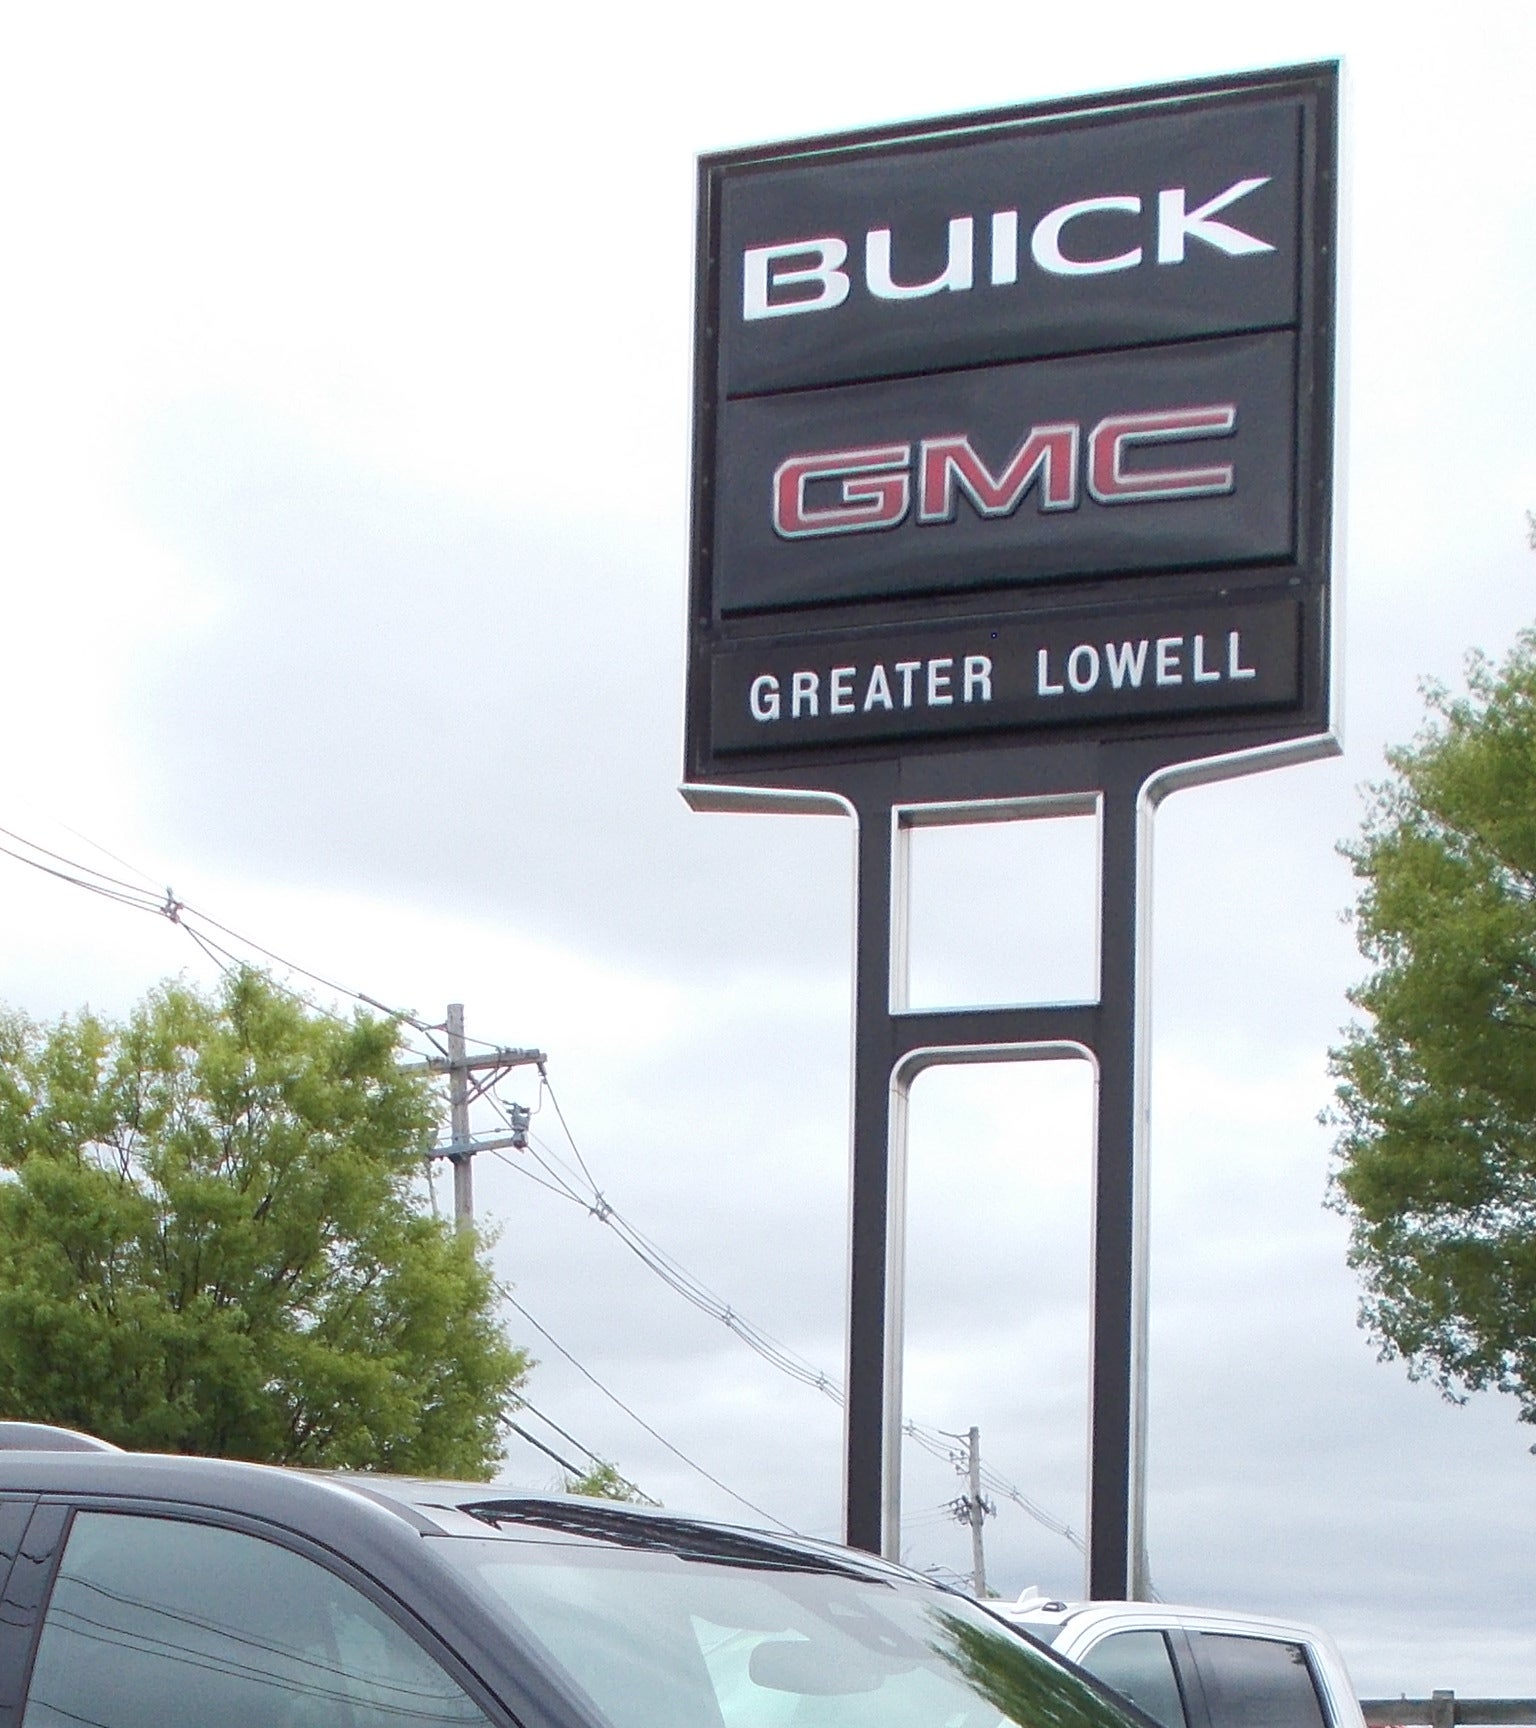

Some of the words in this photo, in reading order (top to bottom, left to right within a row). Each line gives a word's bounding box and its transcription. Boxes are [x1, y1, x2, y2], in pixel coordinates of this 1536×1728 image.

[743, 177, 1277, 320] BUICK
[773, 405, 1237, 539] GMC
[750, 655, 994, 721] GREATER
[1037, 631, 1257, 698] LOWELL
